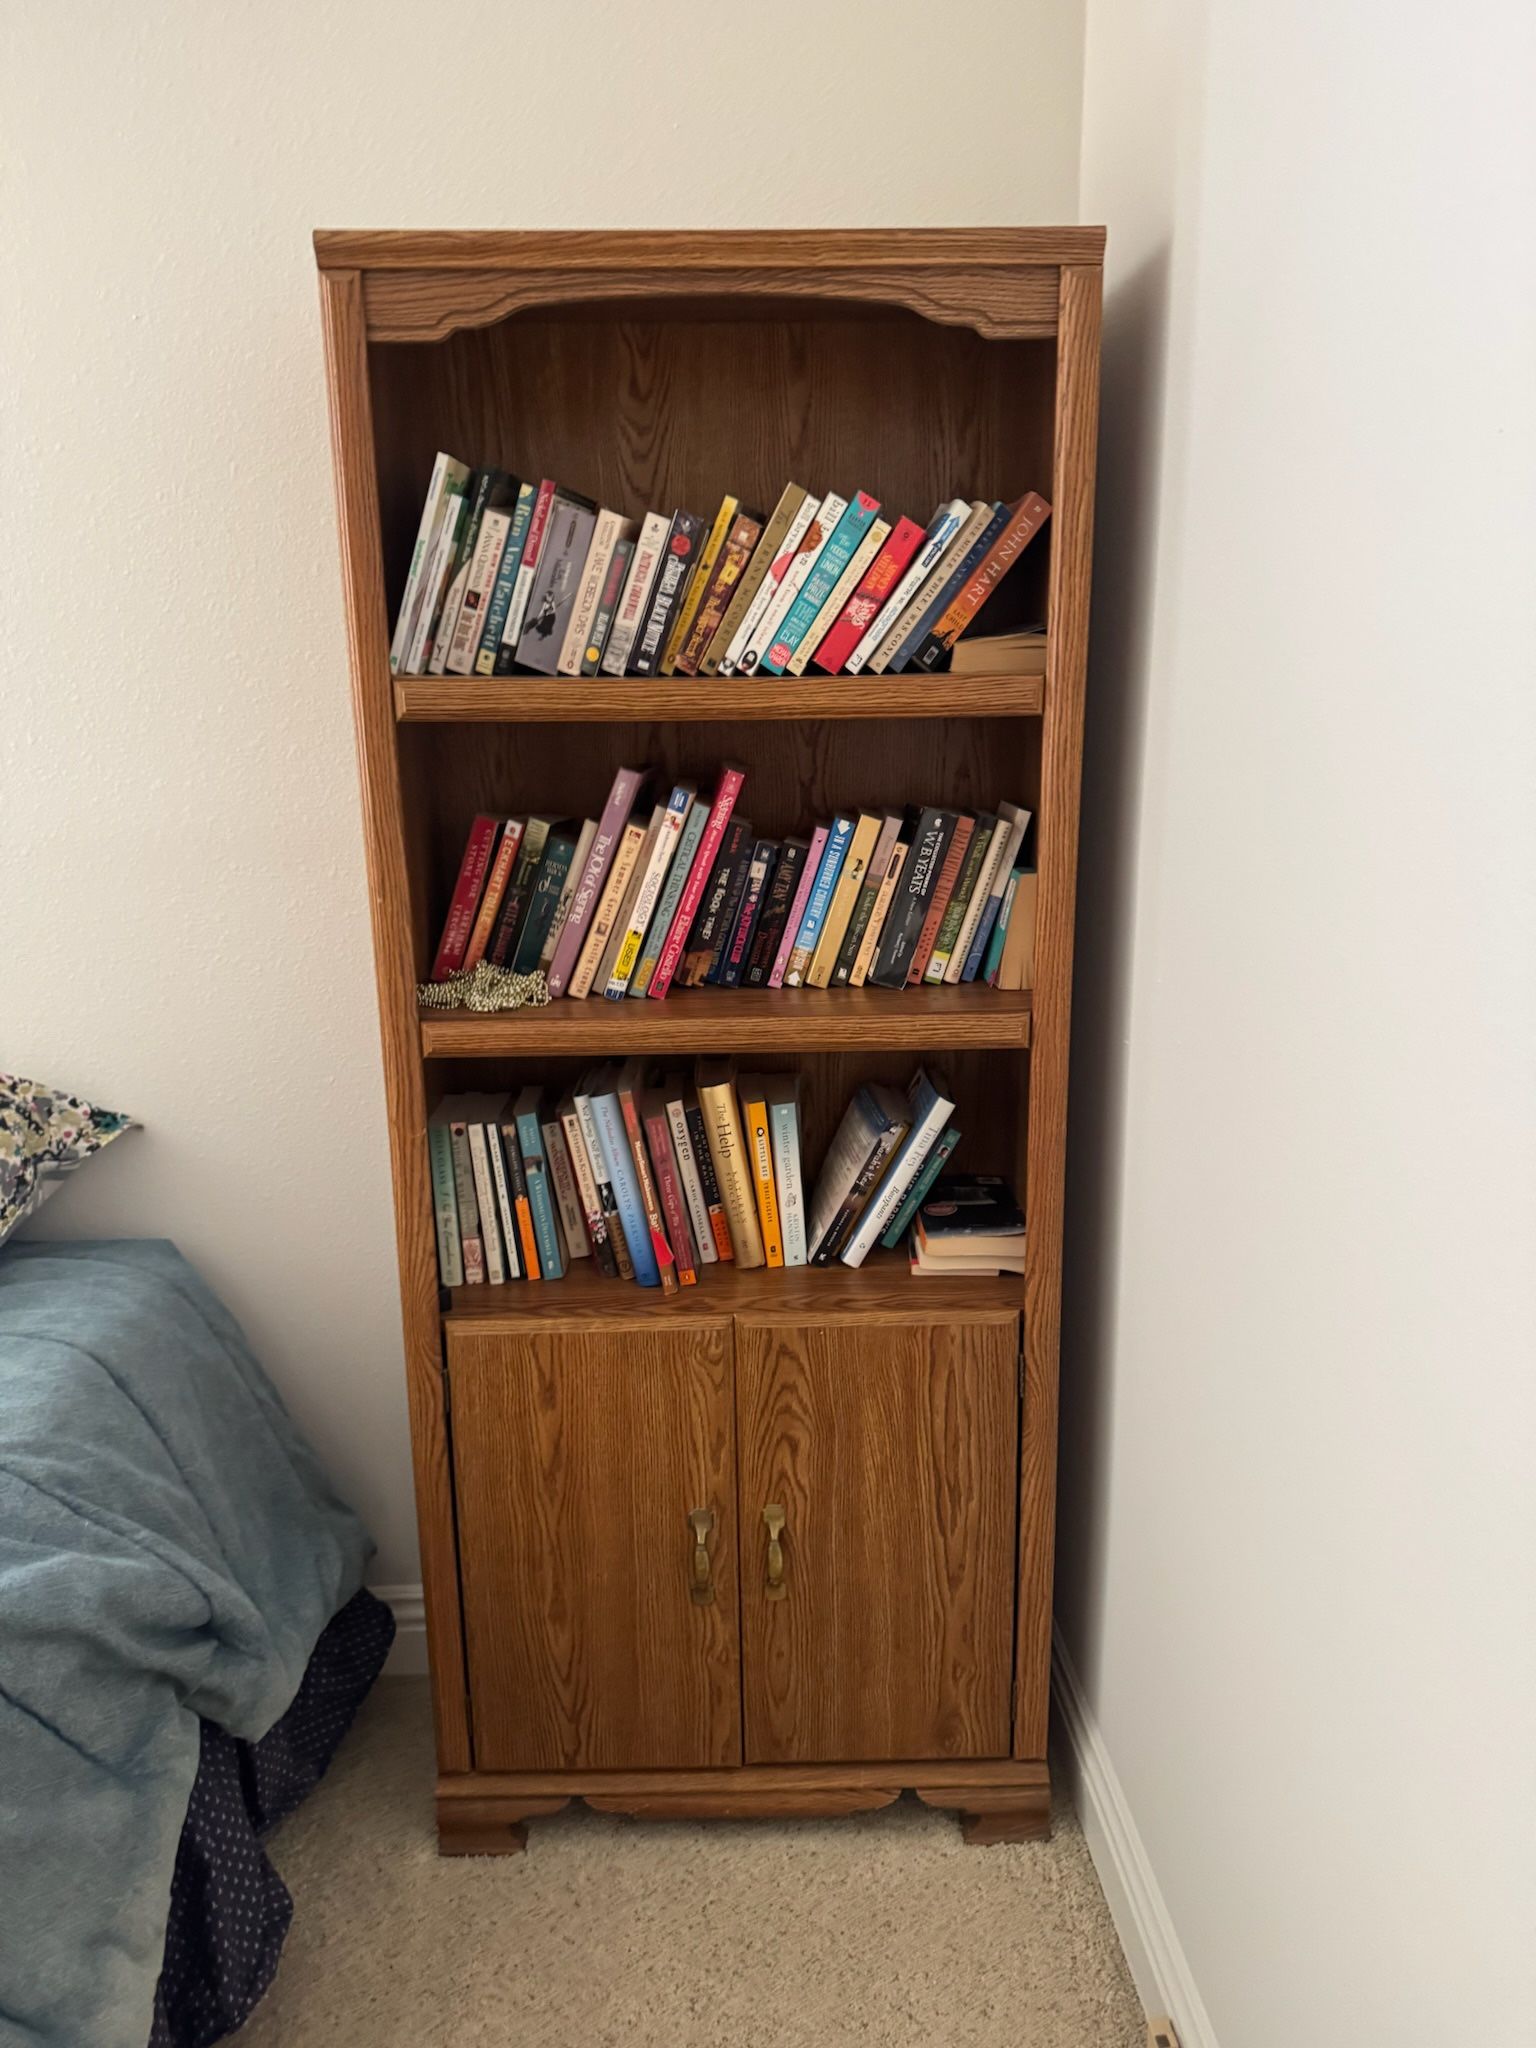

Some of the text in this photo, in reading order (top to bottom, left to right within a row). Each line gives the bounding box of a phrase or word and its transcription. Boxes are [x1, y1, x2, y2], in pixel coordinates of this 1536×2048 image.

[510, 502, 531, 537] Run
[823, 498, 844, 524] bill
[945, 536, 970, 570] MILLER
[963, 514, 1034, 608] JOHN HART
[920, 573, 944, 605] WHILE
[483, 579, 512, 648] Patchett
[900, 611, 917, 631] WAS
[778, 627, 801, 647] CLAY
[881, 630, 902, 658] GONE
[707, 791, 733, 831] Signing
[462, 843, 479, 878] STONE
[467, 828, 493, 899] CUTTING FOR
[489, 838, 515, 890] ECKHART
[675, 829, 698, 873] CRITICAL
[830, 842, 843, 851] A
[907, 828, 938, 895] W. B. YEATS
[990, 840, 1004, 870] BRIDGES
[567, 831, 612, 926] The JOY of Signing
[771, 861, 795, 901] AMY TAN
[818, 849, 840, 889] SUNBURNED
[479, 889, 499, 924] TOLLE
[634, 870, 662, 927] SOCIOLOGY
[659, 872, 683, 918] THINKING
[700, 866, 731, 941] THE BOOK THIEF
[808, 887, 828, 920] COUNTRY
[861, 889, 875, 911] Under
[658, 913, 690, 981] Elaine Costello
[846, 943, 855, 957] Sun
[850, 921, 863, 943] Tuscan
[620, 942, 636, 968] USED
[672, 1120, 691, 1161] oxygen
[712, 1103, 736, 1160] The Help
[917, 1123, 940, 1152] Tina
[437, 1156, 448, 1184] GLASS
[693, 1130, 710, 1186] IN THE RAIN
[696, 1114, 719, 1199] THE ART OF RACING
[781, 1123, 795, 1189] winter garden
[855, 1139, 892, 1189] Sarah's Key
[903, 1147, 924, 1170] Fey
[615, 1168, 632, 1211] CAROLYN
[688, 1178, 707, 1240] CAROL CASSELLA
[724, 1172, 740, 1225] STOCKETT
[873, 1183, 901, 1221] Bossypants
[786, 1212, 794, 1245] HANNAH
[792, 1213, 800, 1242] KRISTIN
